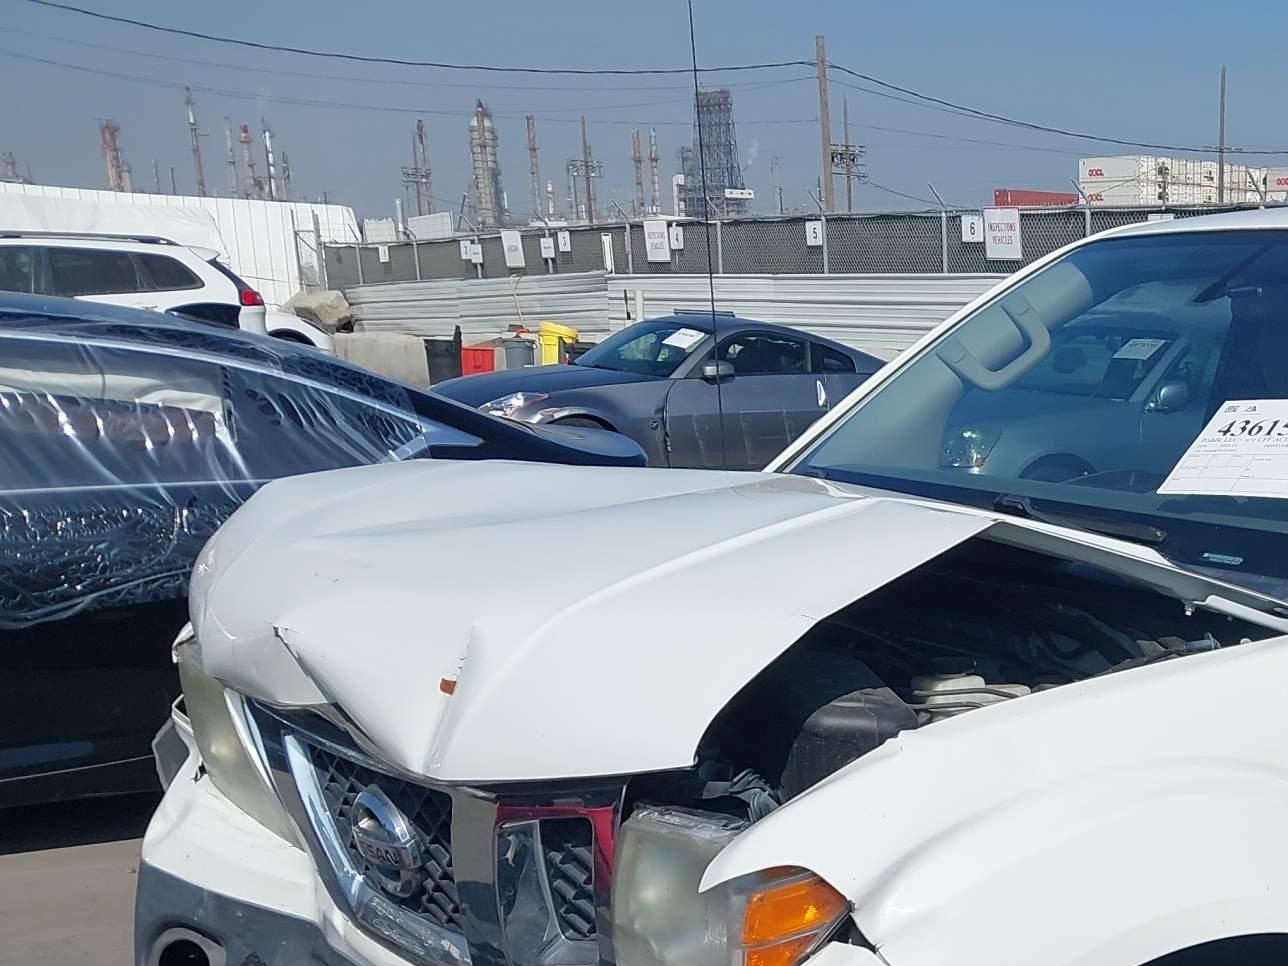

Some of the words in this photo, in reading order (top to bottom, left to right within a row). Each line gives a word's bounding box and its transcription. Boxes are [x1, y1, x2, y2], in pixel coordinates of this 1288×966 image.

[1088, 168, 1104, 177] OOCL
[969, 221, 976, 236] 6
[988, 222, 1016, 232] INSPECTIONS
[812, 227, 818, 240] 5
[992, 236, 1013, 245] VEHICLES
